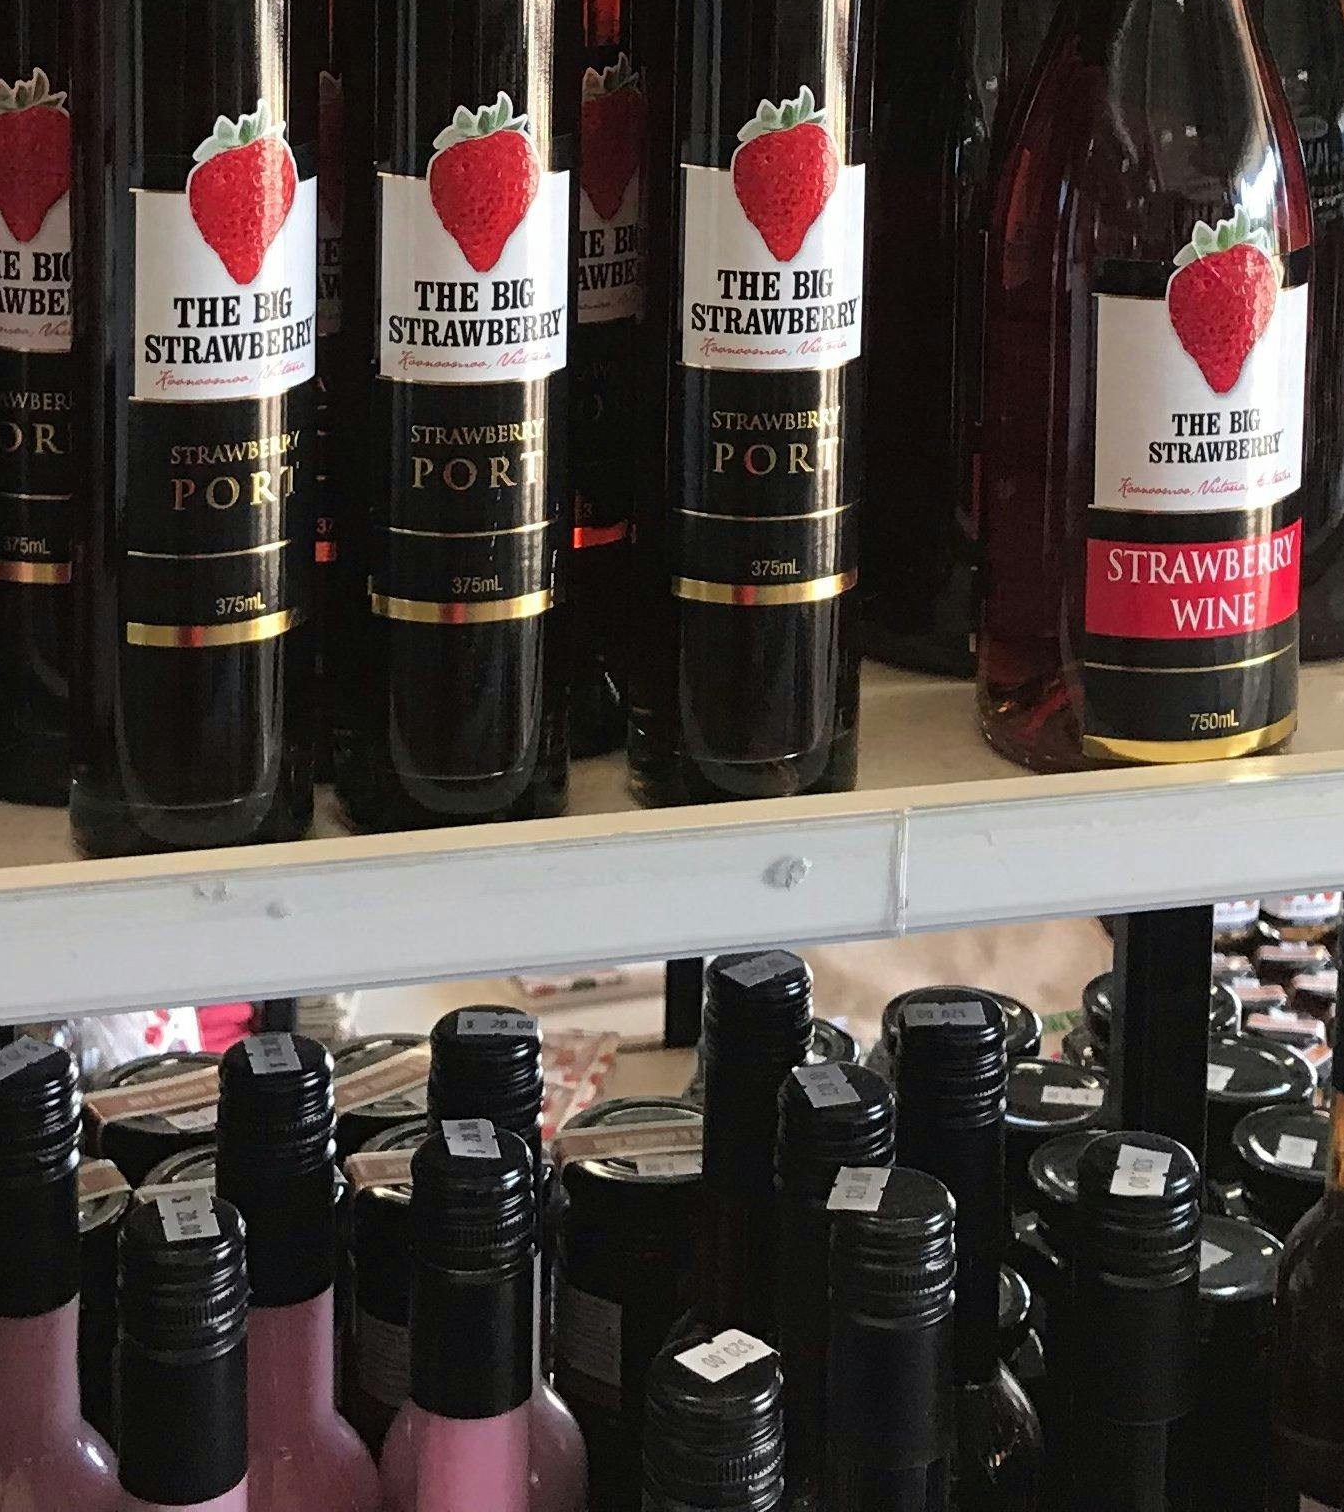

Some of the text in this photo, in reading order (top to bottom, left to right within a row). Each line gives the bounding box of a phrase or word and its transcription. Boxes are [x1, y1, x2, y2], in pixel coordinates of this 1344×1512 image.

[413, 277, 536, 314] THE BIG
[717, 268, 834, 302] THE BIG
[173, 285, 293, 329] THE BIG
[691, 297, 858, 336] STRAWBERRY
[143, 313, 314, 366] STRAWBERRY
[388, 305, 564, 349] STRAWBERRY
[410, 417, 546, 447] STRAWBERRY
[710, 405, 842, 432] STRAWBERRY
[1172, 408, 1262, 438] THE BIG
[712, 435, 840, 476] PORT
[1148, 428, 1283, 465] STRAWBERRY
[411, 449, 544, 492] PORT
[750, 558, 802, 577] 375mL
[1106, 530, 1296, 586] STRAWBERRY
[451, 573, 504, 595] 375mL
[215, 592, 267, 617] 375mL
[1170, 591, 1257, 633] WINE
[1189, 709, 1240, 732] 750mL
